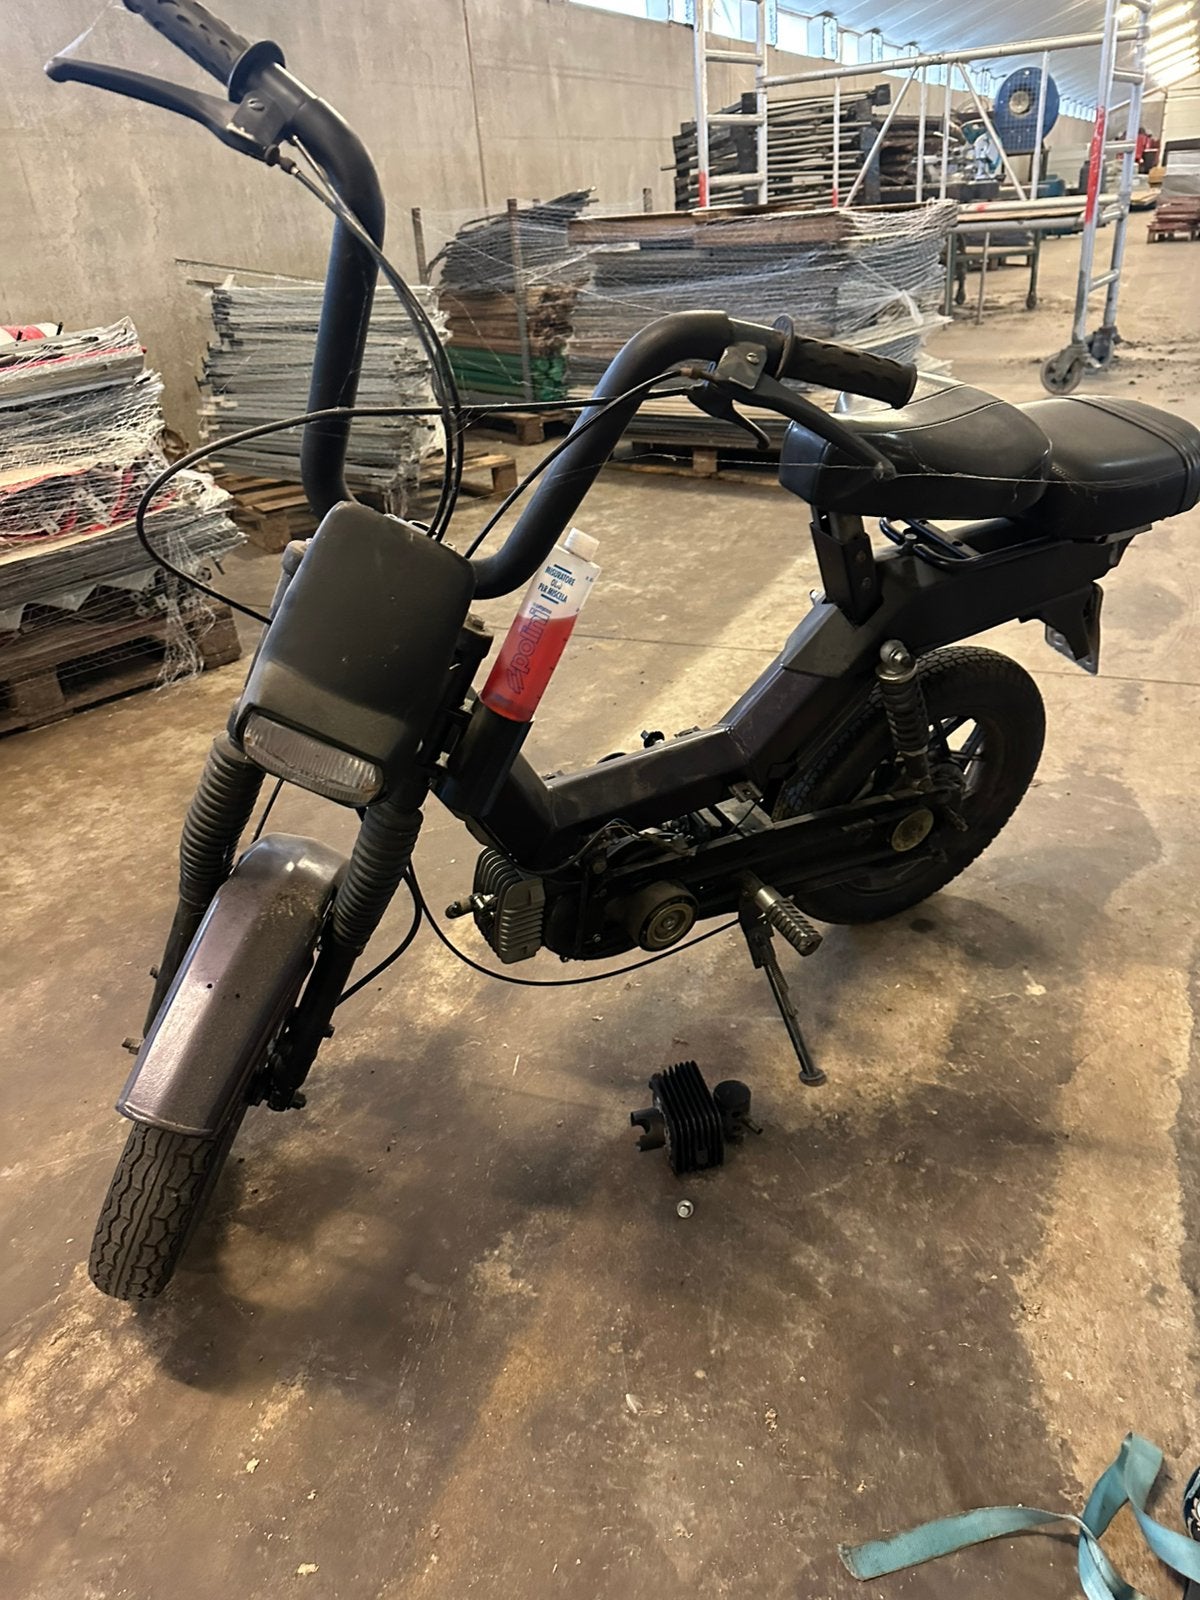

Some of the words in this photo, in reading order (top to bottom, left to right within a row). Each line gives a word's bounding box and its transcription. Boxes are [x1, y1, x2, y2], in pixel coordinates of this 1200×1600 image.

[544, 566, 576, 586] MISURATORE
[537, 582, 549, 593] PER
[546, 587, 568, 603] MISCELA
[511, 607, 552, 675] polini
